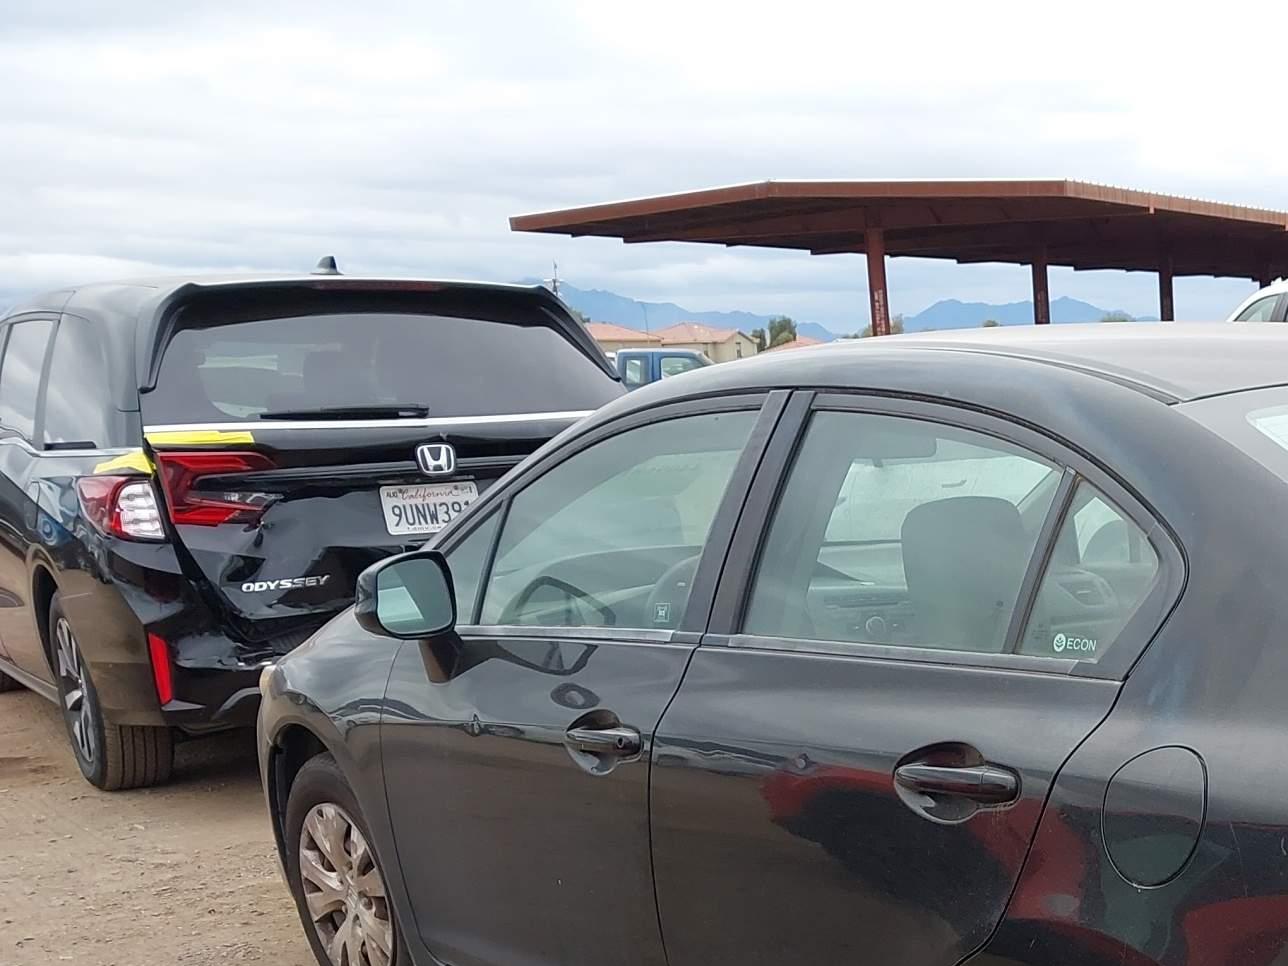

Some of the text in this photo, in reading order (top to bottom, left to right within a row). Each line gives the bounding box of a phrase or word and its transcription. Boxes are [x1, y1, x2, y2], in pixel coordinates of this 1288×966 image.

[402, 487, 459, 501] California
[391, 501, 470, 527] 9UNW39
[241, 574, 330, 593] ODYSSEY
[1066, 637, 1097, 652] ECON
